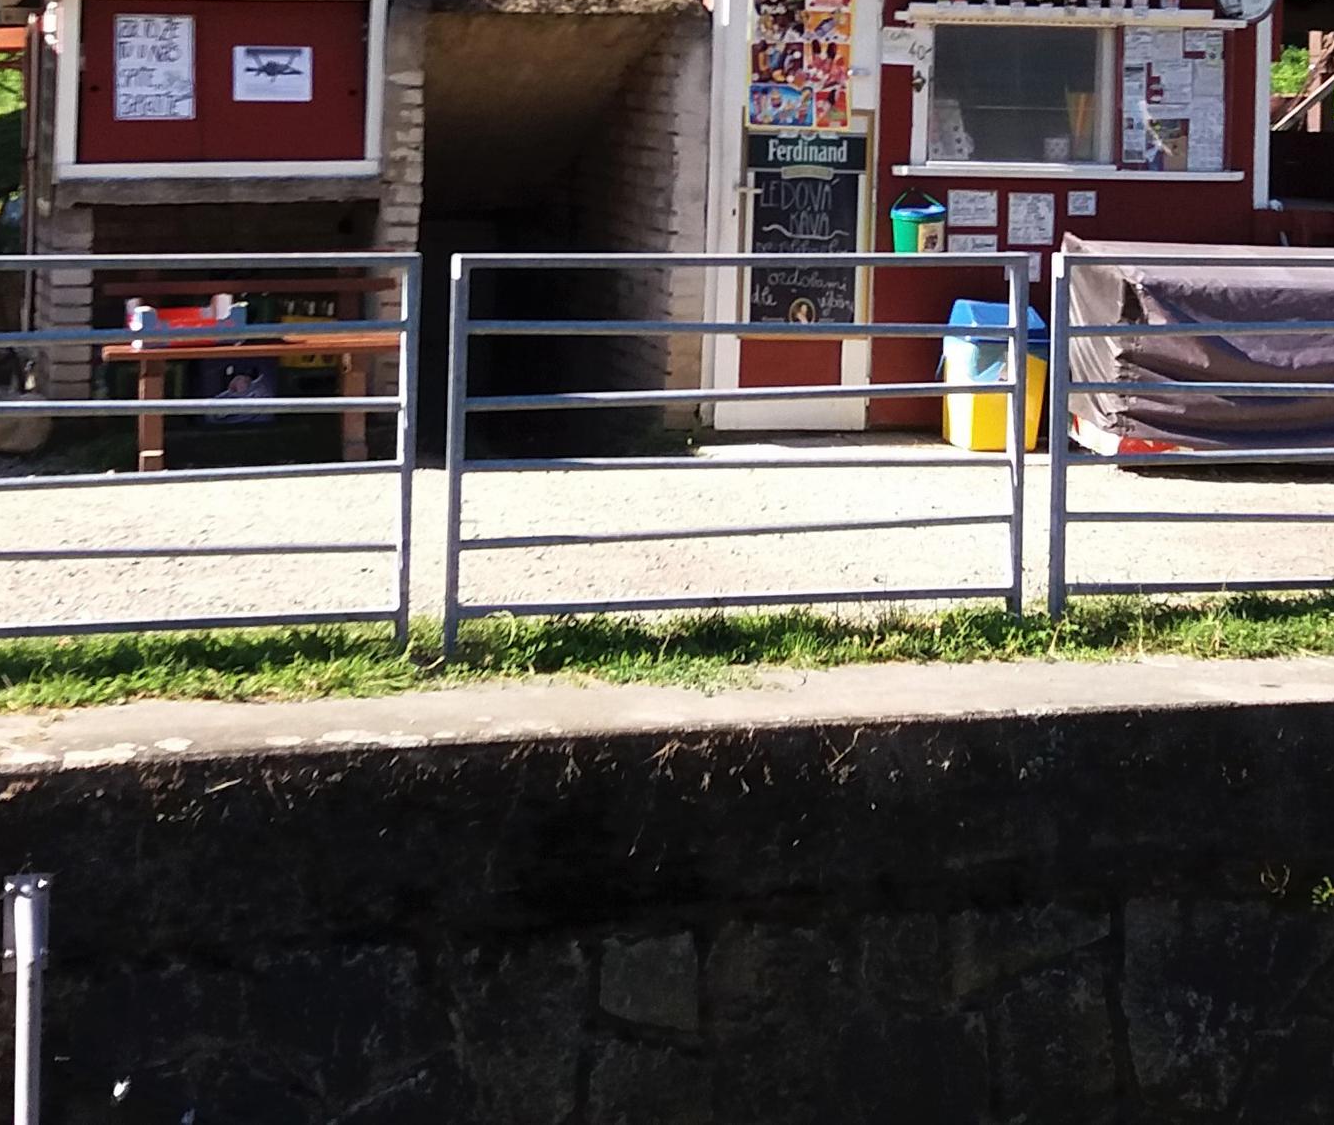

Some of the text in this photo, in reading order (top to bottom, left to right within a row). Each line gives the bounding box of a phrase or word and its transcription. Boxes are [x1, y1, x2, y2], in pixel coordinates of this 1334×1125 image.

[768, 138, 848, 163] Ferdinand
[759, 178, 840, 212] LEDOVÁ
[788, 205, 830, 237] KÁVA
